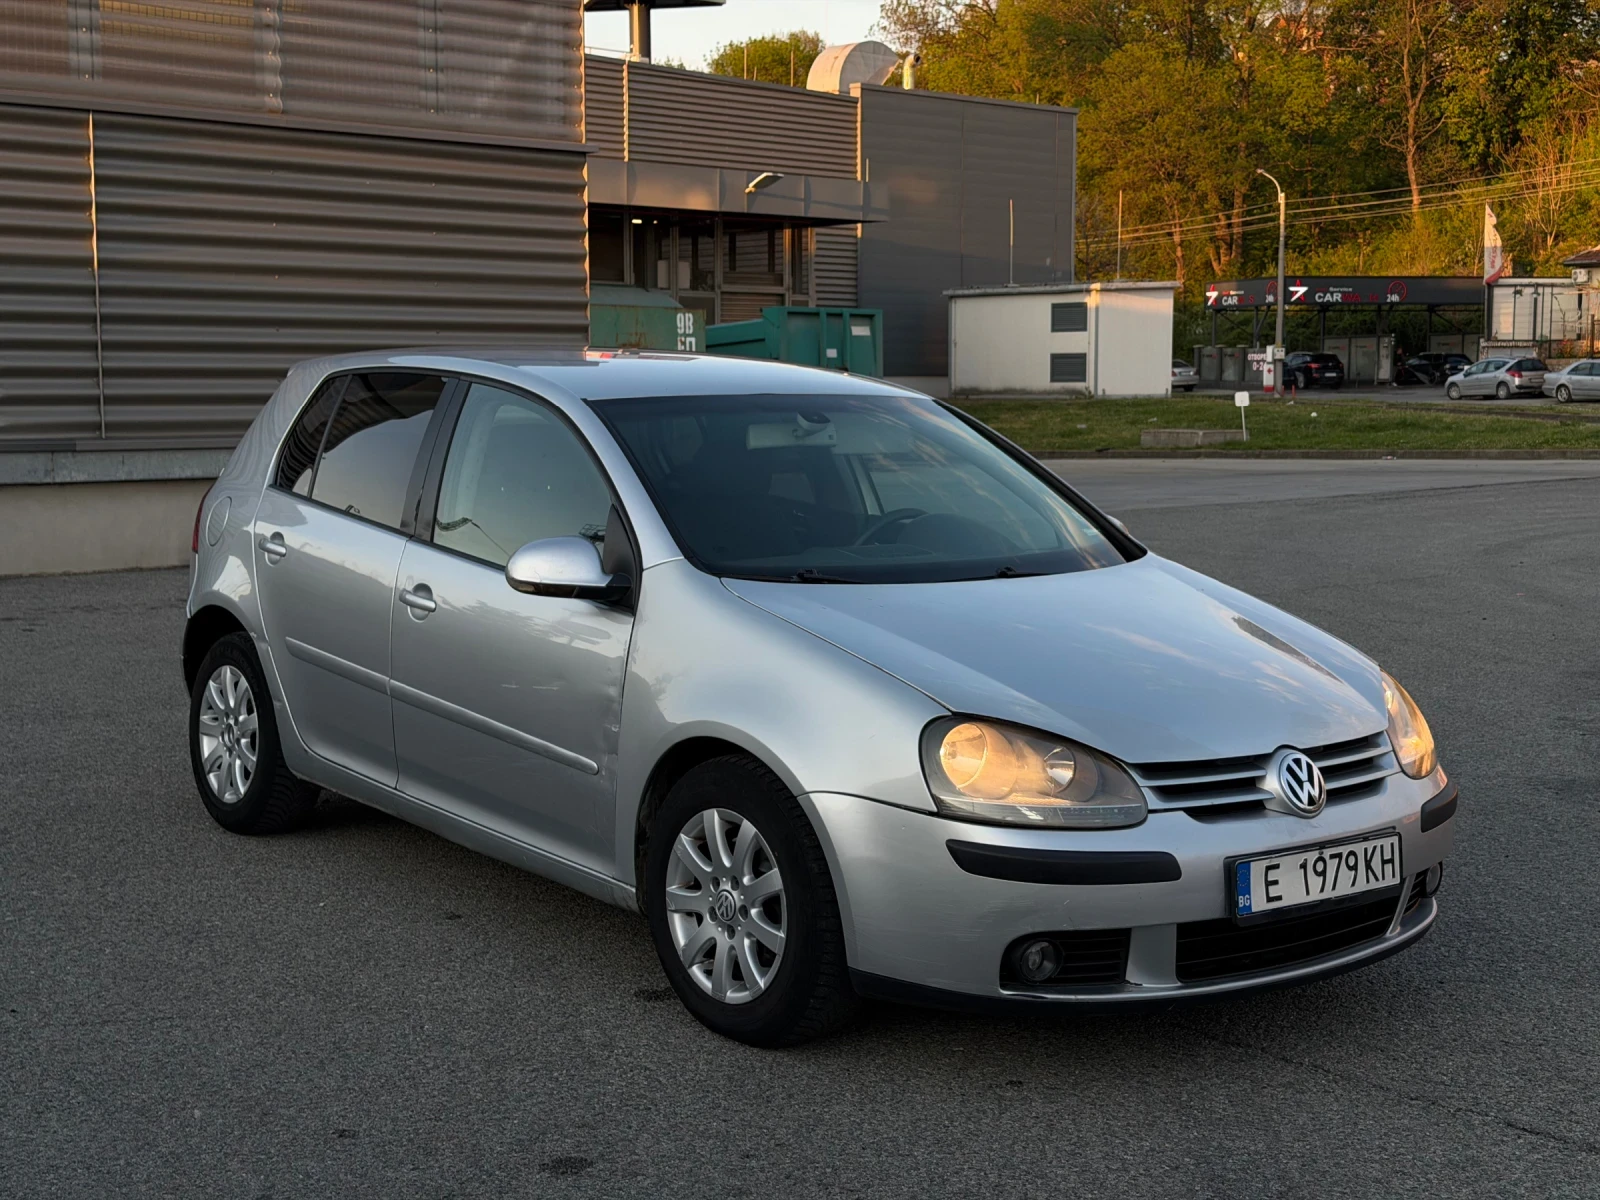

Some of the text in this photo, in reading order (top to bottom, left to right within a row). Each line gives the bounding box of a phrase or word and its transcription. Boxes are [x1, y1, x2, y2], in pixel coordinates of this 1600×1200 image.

[1386, 293, 1400, 303] 24h
[1263, 862, 1284, 904] E
[1238, 894, 1251, 908] BG
